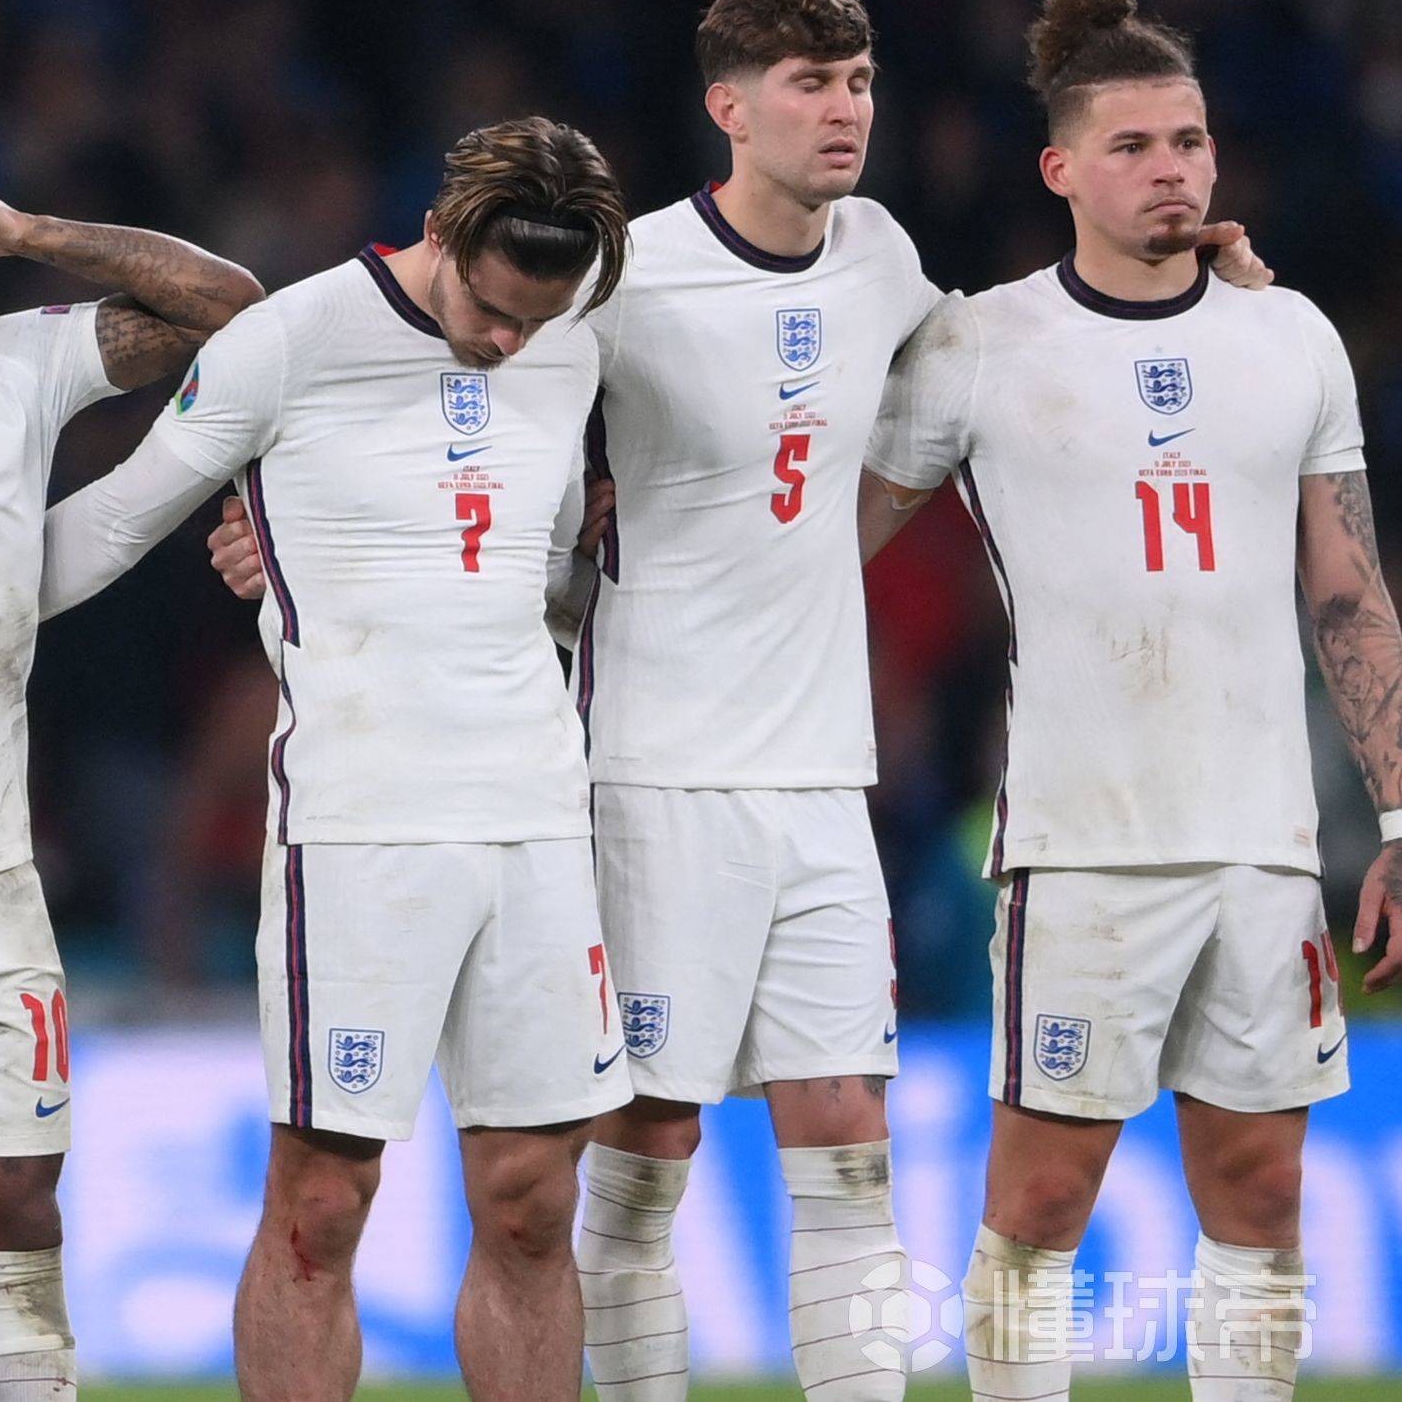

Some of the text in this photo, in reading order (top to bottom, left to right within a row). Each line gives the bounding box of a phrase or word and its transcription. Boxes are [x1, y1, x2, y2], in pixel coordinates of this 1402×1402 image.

[770, 434, 811, 524] 5
[455, 493, 492, 572] 7
[1137, 481, 1215, 572] 14
[588, 943, 608, 1035] 7
[19, 988, 69, 1084] 10
